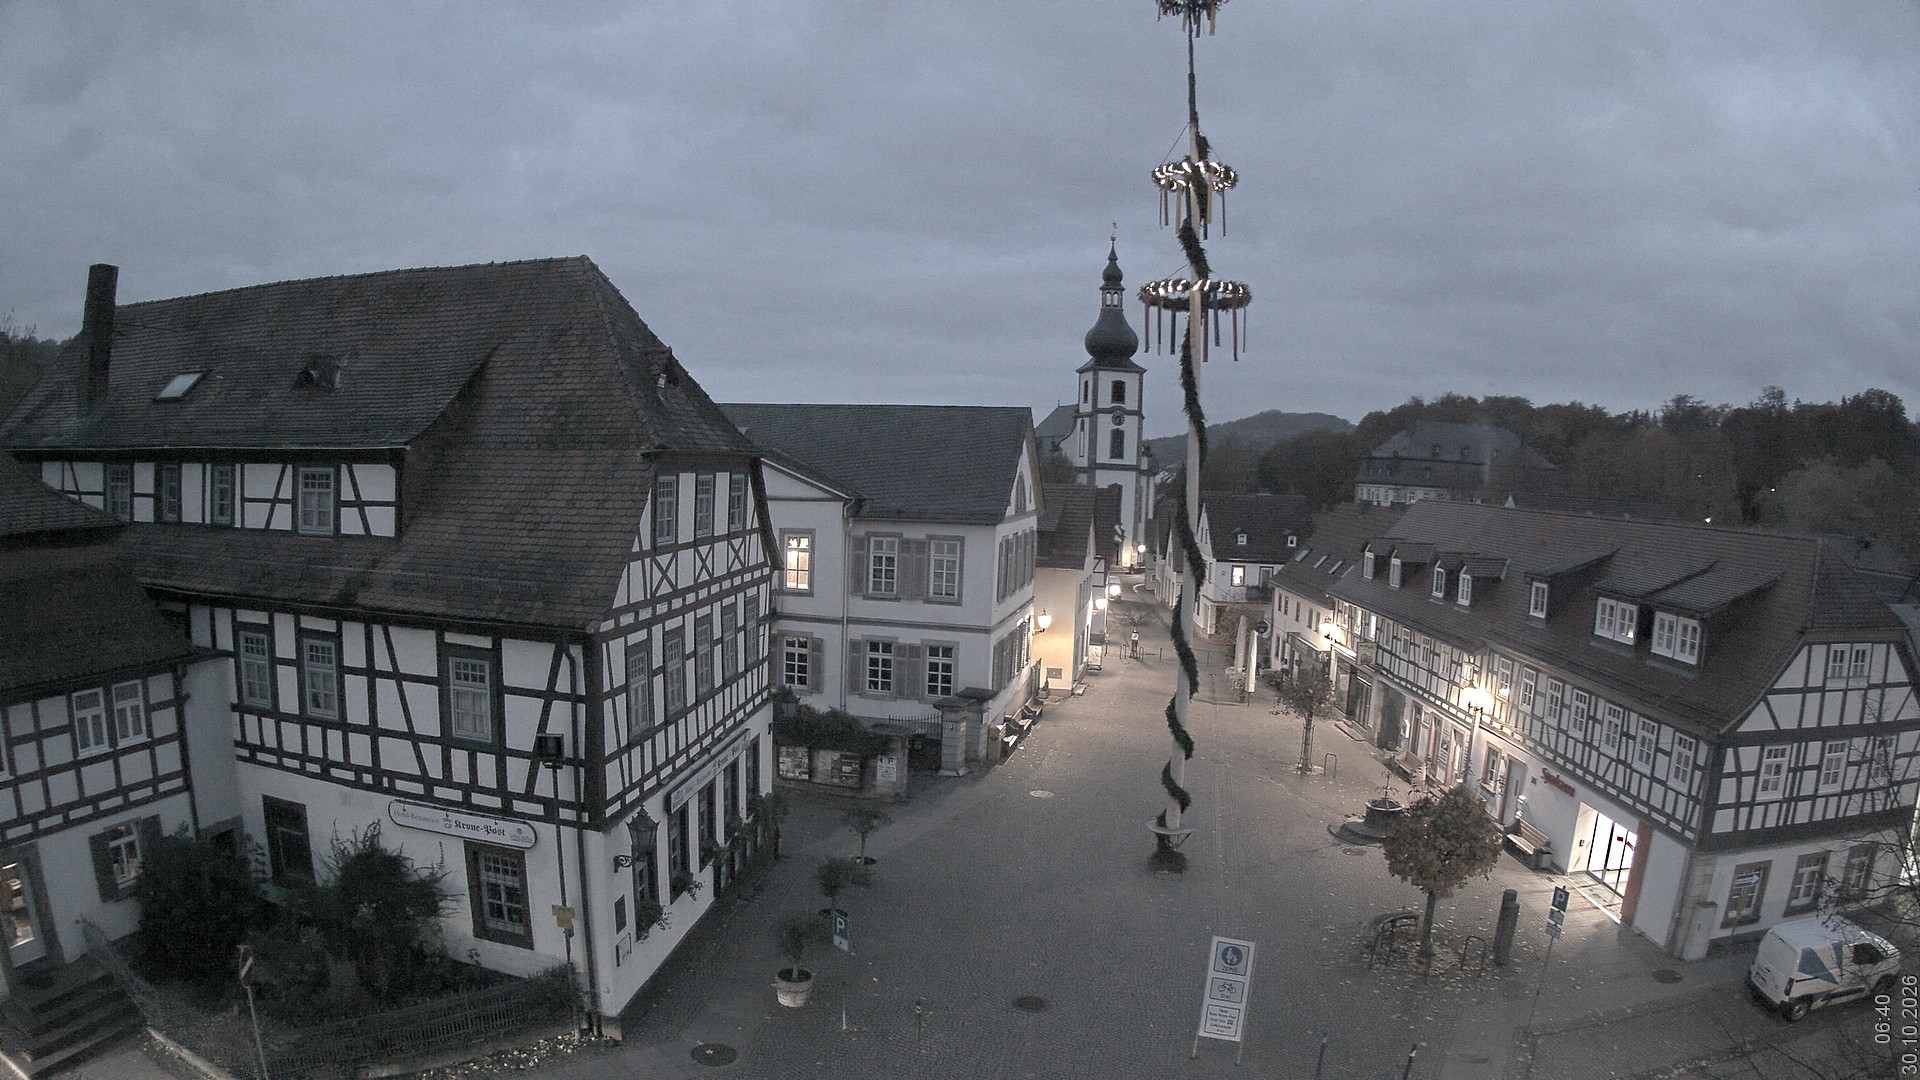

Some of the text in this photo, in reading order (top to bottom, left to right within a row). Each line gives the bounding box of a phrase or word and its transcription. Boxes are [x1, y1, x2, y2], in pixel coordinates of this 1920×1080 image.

[454, 819, 506, 836] Krone-Post
[1554, 890, 1566, 906] P
[836, 916, 845, 933] P
[1221, 965, 1237, 973] ZONE
